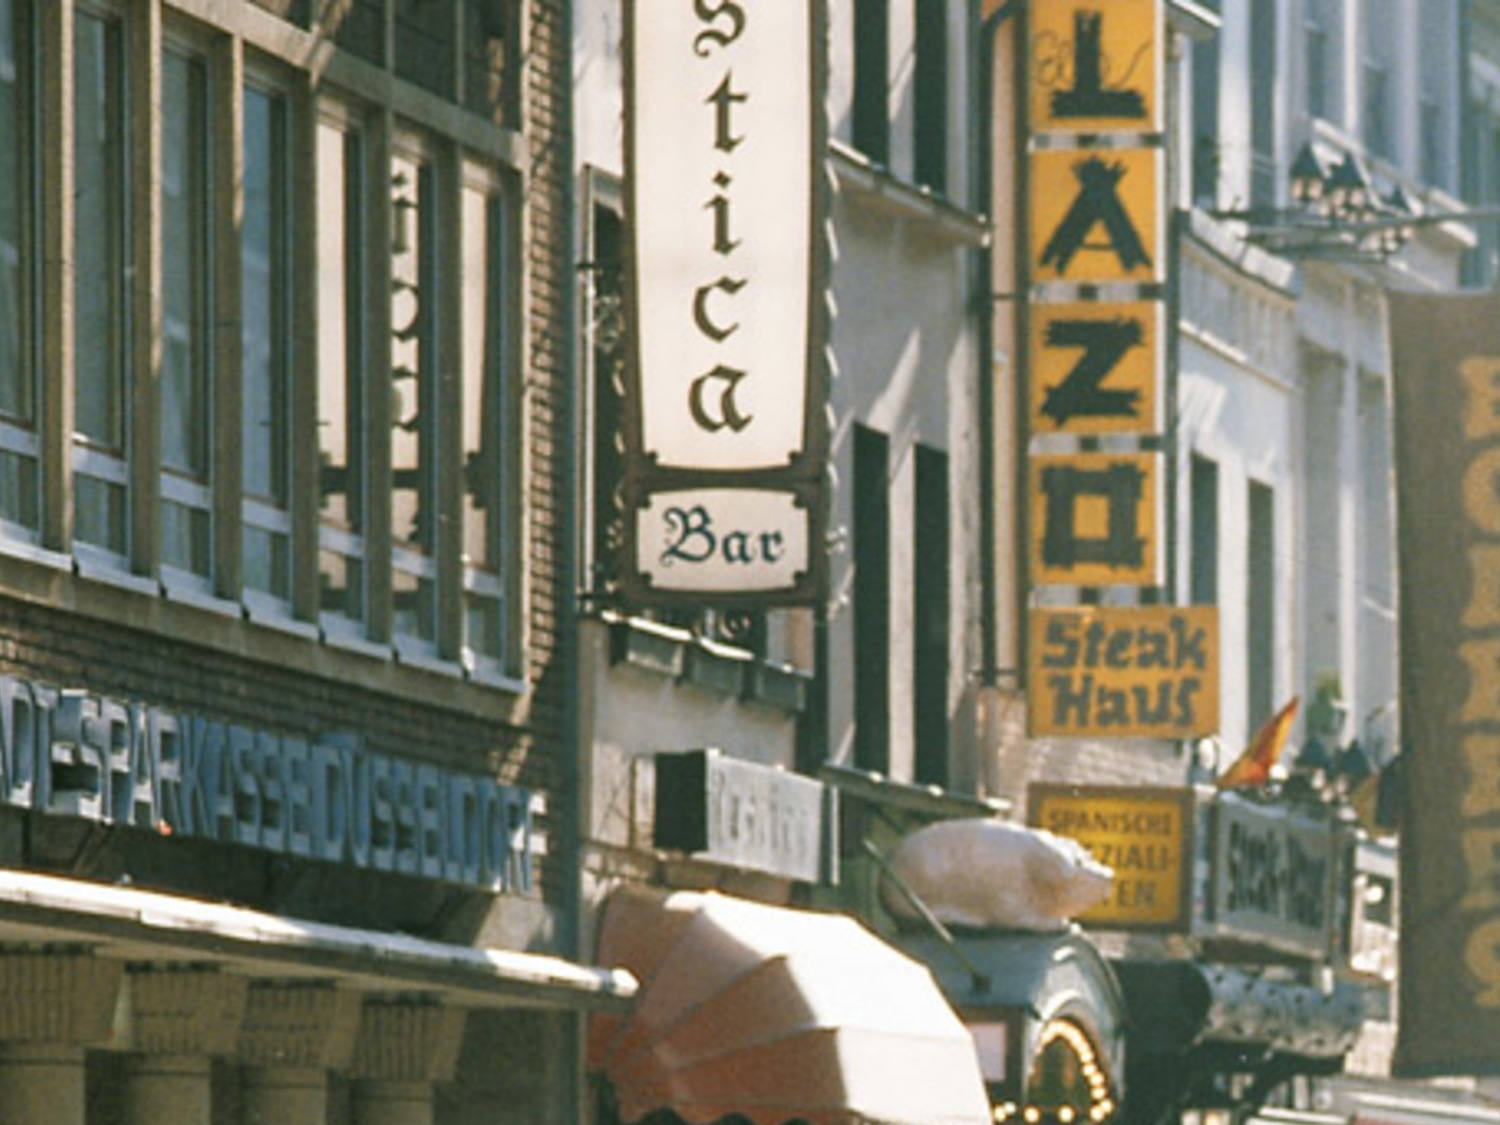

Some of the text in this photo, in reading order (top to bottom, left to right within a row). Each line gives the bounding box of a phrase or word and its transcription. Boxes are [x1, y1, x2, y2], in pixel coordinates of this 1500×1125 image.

[658, 504, 786, 568] Bar
[1043, 612, 1207, 670] Steak
[1049, 672, 1200, 728] Haus
